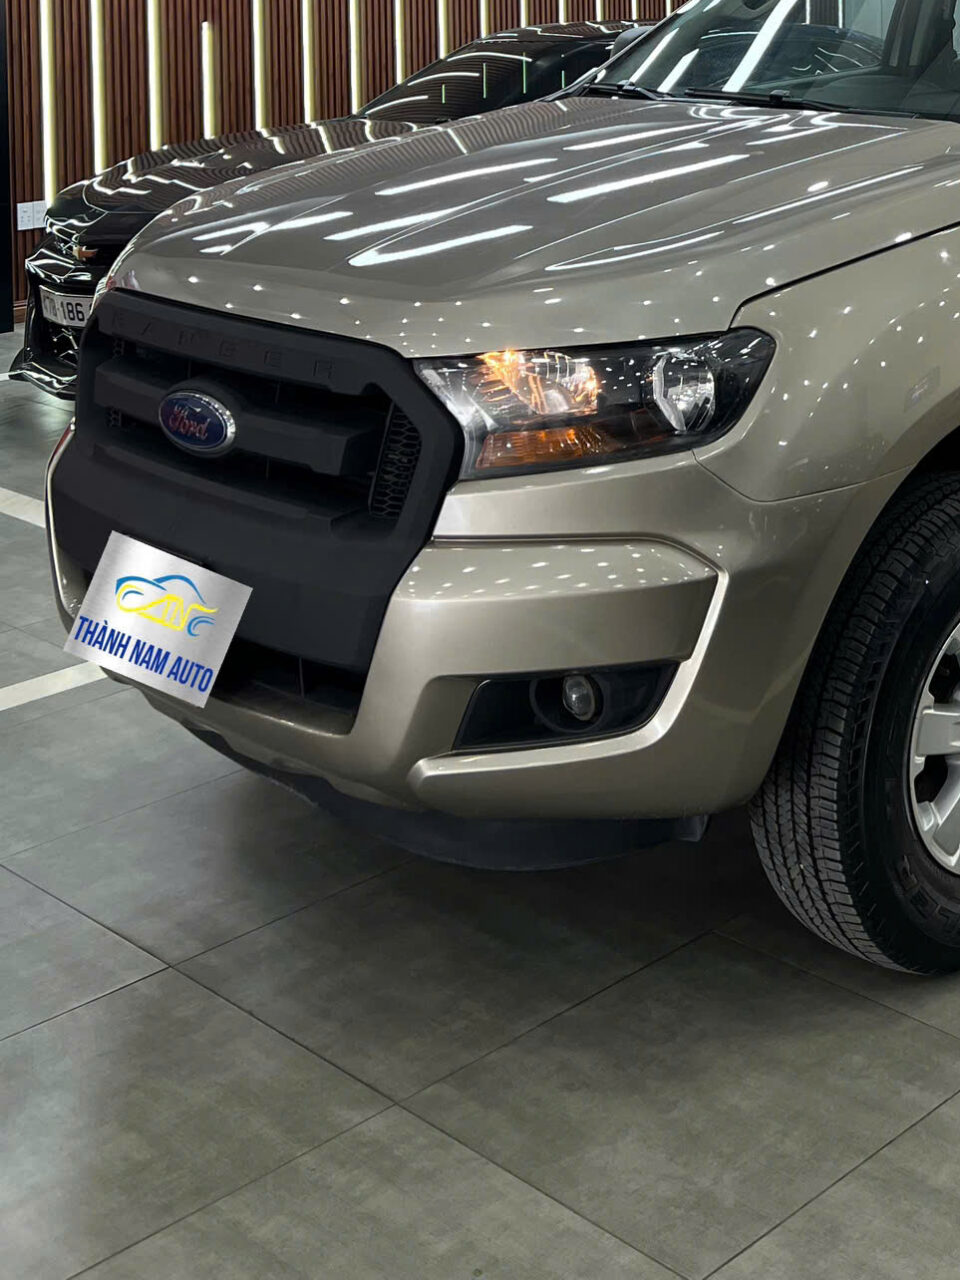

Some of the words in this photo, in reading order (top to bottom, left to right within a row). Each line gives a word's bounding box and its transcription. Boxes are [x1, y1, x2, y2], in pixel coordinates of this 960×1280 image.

[168, 404, 211, 441] Ford
[74, 615, 132, 659] THÀNH
[128, 638, 171, 675] NAM
[166, 655, 214, 693] AUTO
